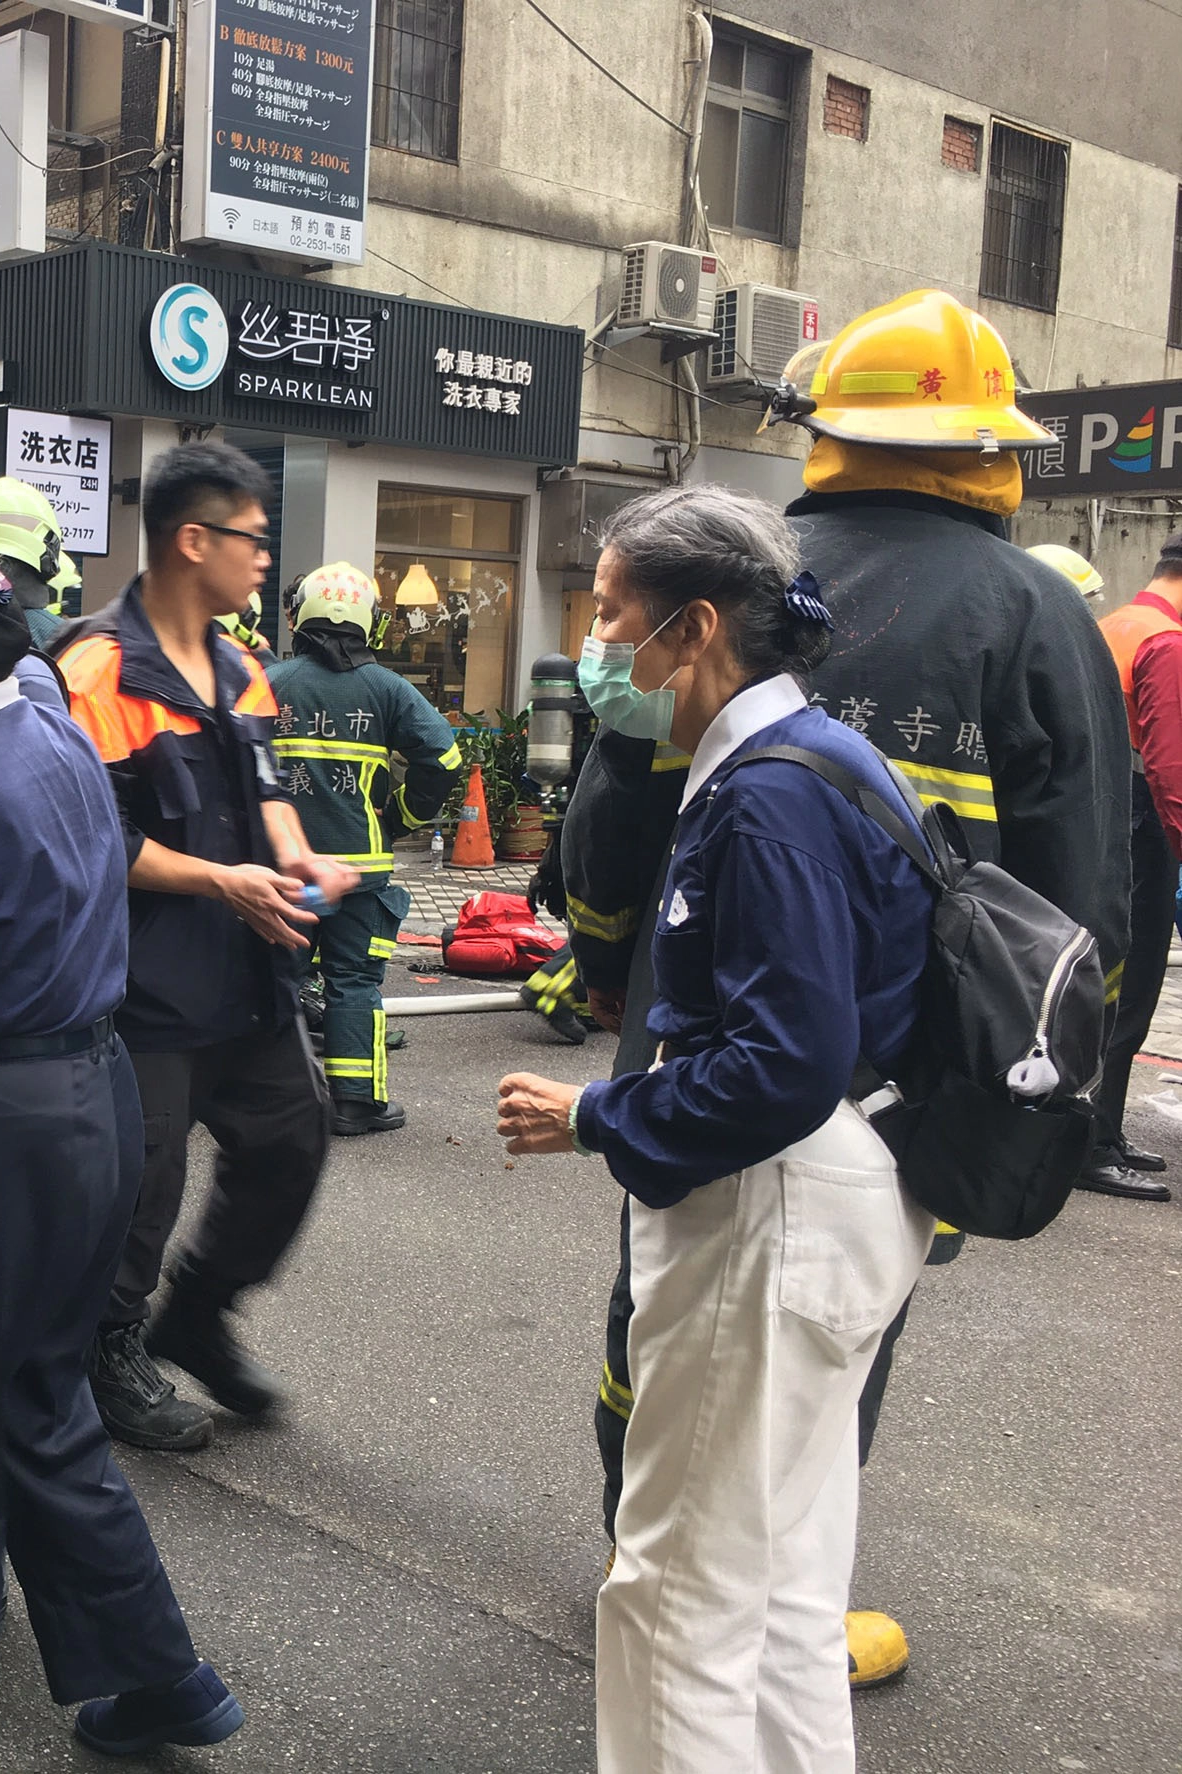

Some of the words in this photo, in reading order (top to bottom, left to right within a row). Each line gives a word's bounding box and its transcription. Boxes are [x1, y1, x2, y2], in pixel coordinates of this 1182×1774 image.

[220, 25, 229, 40] B
[234, 27, 307, 62] 徹底放鬆方案
[315, 49, 354, 74] 1300元
[233, 52, 254, 67] 10分
[256, 56, 275, 73] 足湯
[231, 68, 253, 83] 40分
[231, 83, 253, 99] 60分
[216, 130, 226, 146] C
[230, 131, 304, 164] 雙人共享方案
[310, 150, 350, 174] 2400元
[229, 156, 251, 171] 90分
[252, 219, 279, 235] 日本語
[291, 215, 352, 241] 預約電話
[290, 234, 351, 256] 02-2531-1561
[434, 347, 533, 387] 你最親近的
[239, 373, 372, 408] SPARKLEAN
[442, 381, 521, 415] 洗衣專家
[20, 430, 99, 470] 洗衣店
[81, 477, 98, 490] 24H
[48, 499, 90, 514] ランドリー
[274, 703, 374, 740] 臺北市
[288, 763, 358, 796] 義消
